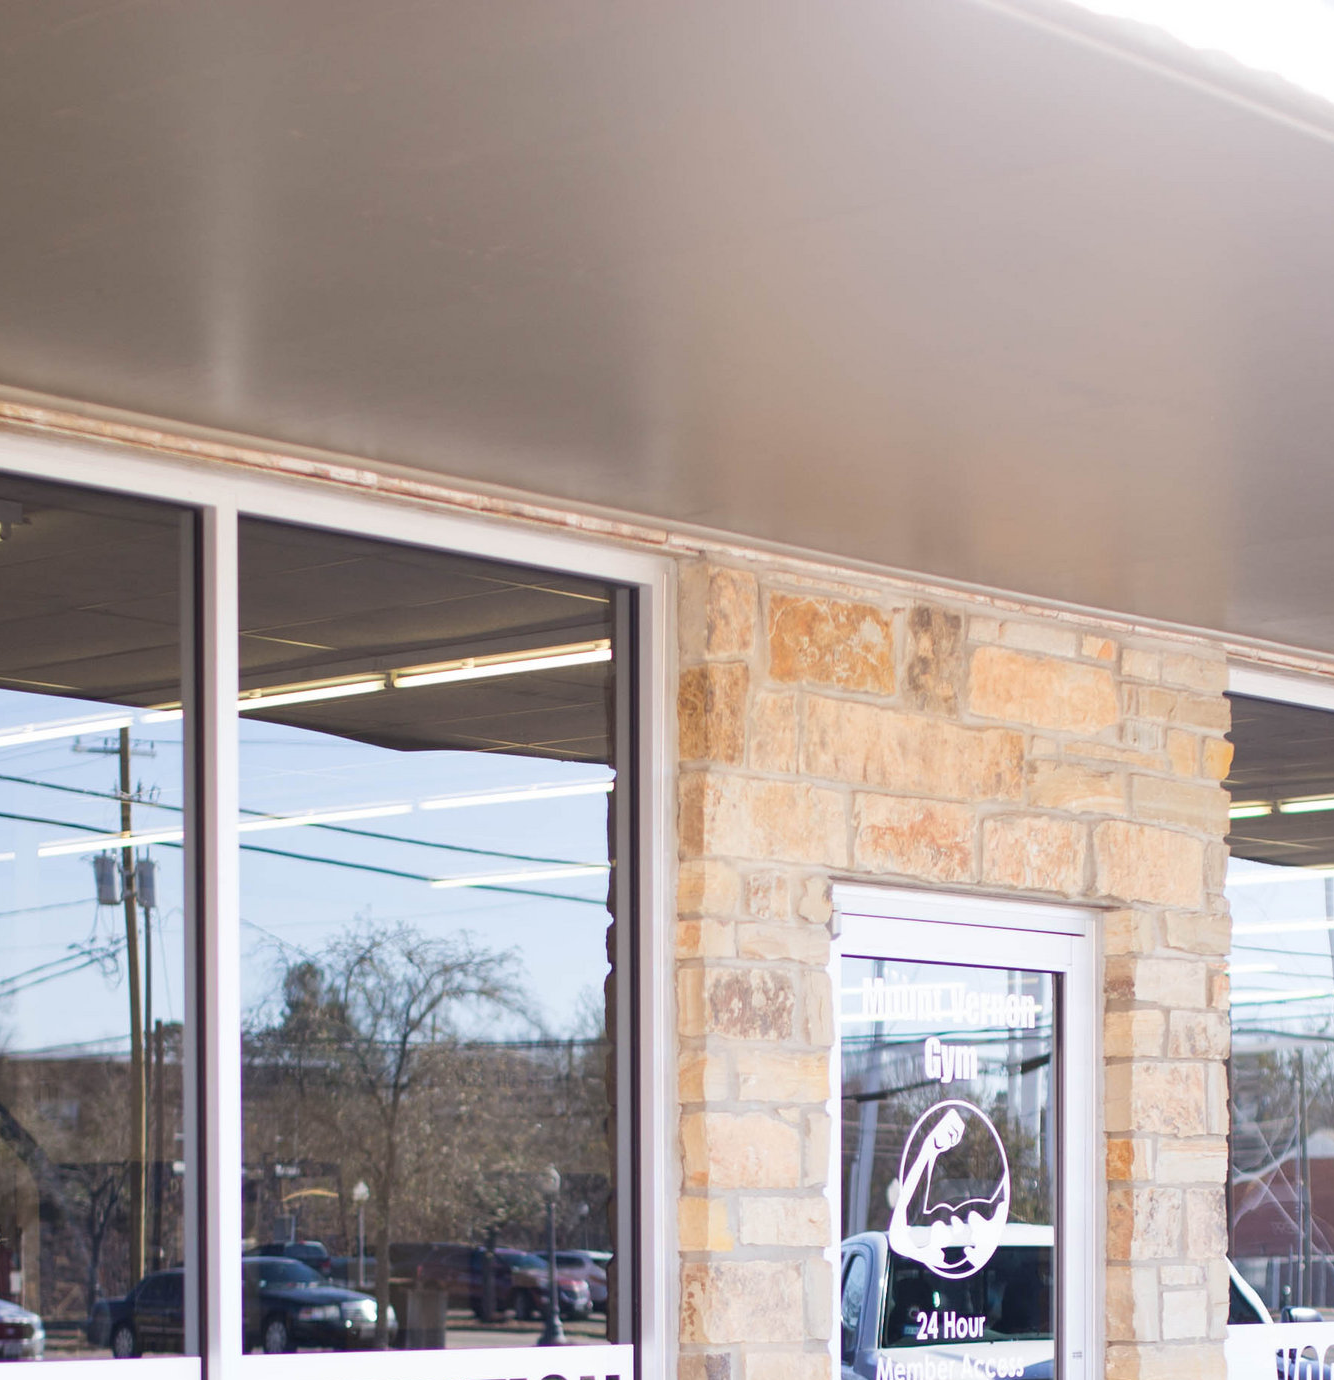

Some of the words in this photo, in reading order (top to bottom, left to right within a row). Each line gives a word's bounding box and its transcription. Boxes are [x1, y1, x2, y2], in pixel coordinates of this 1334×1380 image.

[862, 977, 942, 1022] Mount
[950, 984, 1035, 1028] Vernon
[924, 1036, 977, 1084] Gym
[916, 1311, 939, 1340] 24
[943, 1311, 986, 1339] Hour
[961, 1353, 1025, 1379] Access
